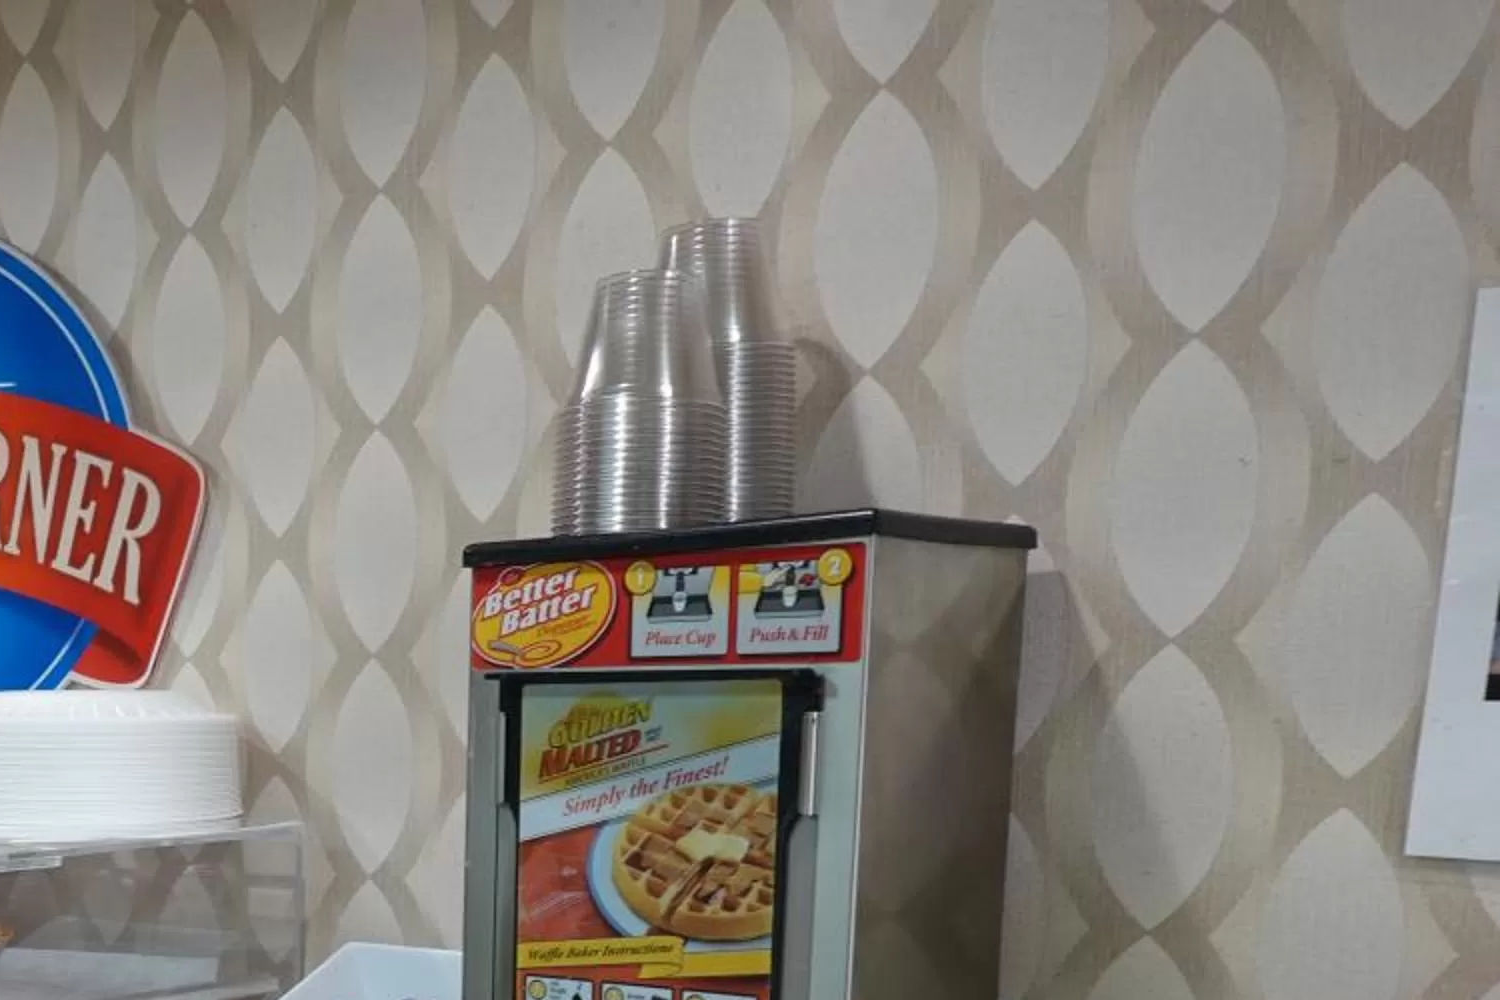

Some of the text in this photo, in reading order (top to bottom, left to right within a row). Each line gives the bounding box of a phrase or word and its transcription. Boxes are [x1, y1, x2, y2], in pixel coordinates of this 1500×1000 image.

[826, 556, 843, 577] 2
[482, 567, 581, 620] Better
[500, 585, 598, 637] Batter
[645, 630, 717, 648] Place Cup
[749, 627, 788, 643] Push
[802, 625, 830, 641] Fill
[538, 730, 642, 778] MALTED
[563, 755, 731, 817] Simply the Finest!
[528, 943, 675, 962] Waffle Baker Instructions
